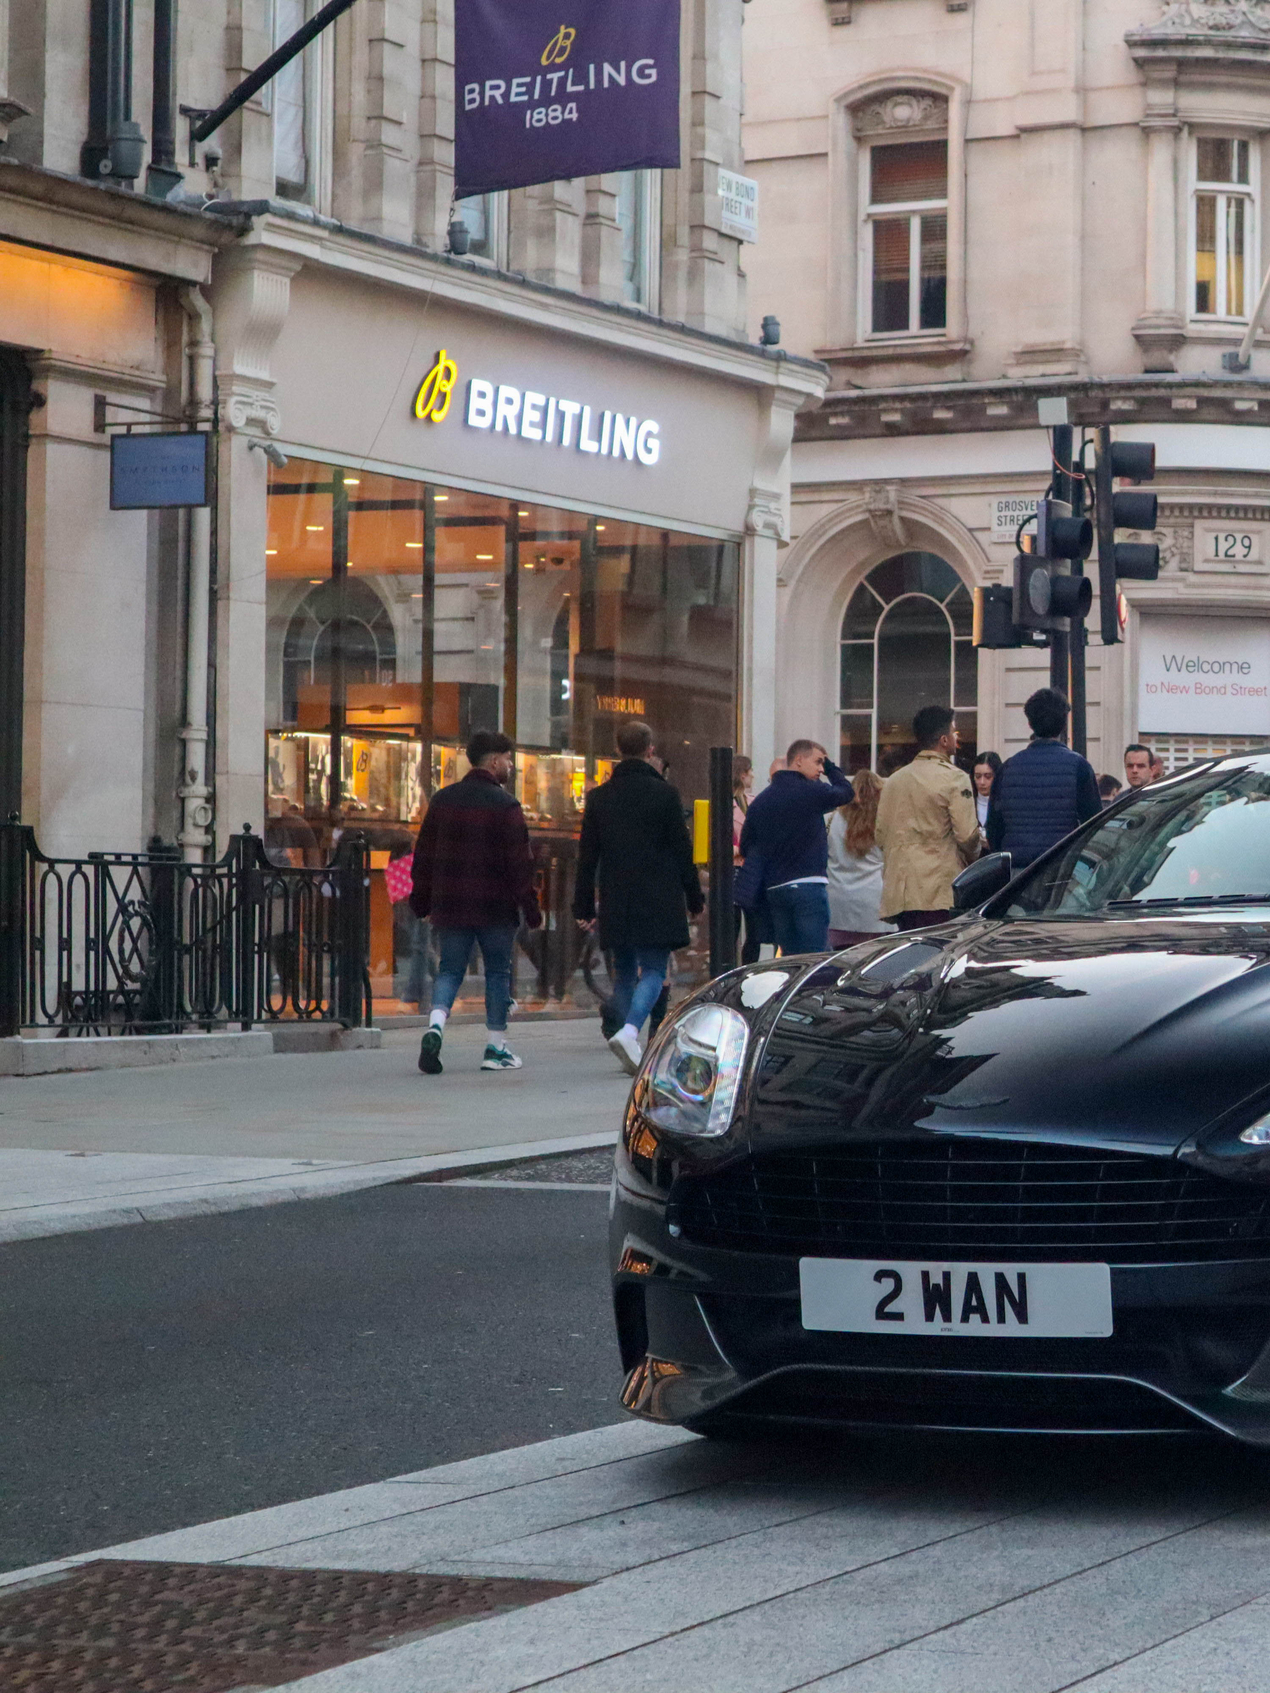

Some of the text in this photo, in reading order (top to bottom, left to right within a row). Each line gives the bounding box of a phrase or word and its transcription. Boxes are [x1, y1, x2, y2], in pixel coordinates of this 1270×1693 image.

[464, 58, 658, 111] BREITLING
[525, 103, 579, 128] 1884
[735, 181, 755, 201] BOND
[468, 378, 661, 466] BREITLING
[997, 501, 1039, 512] GROSVE
[1214, 534, 1252, 558] 129
[1162, 654, 1251, 675] Welcome
[1145, 682, 1268, 697] to New Bond Street
[873, 1269, 1029, 1325] 2 WAN
